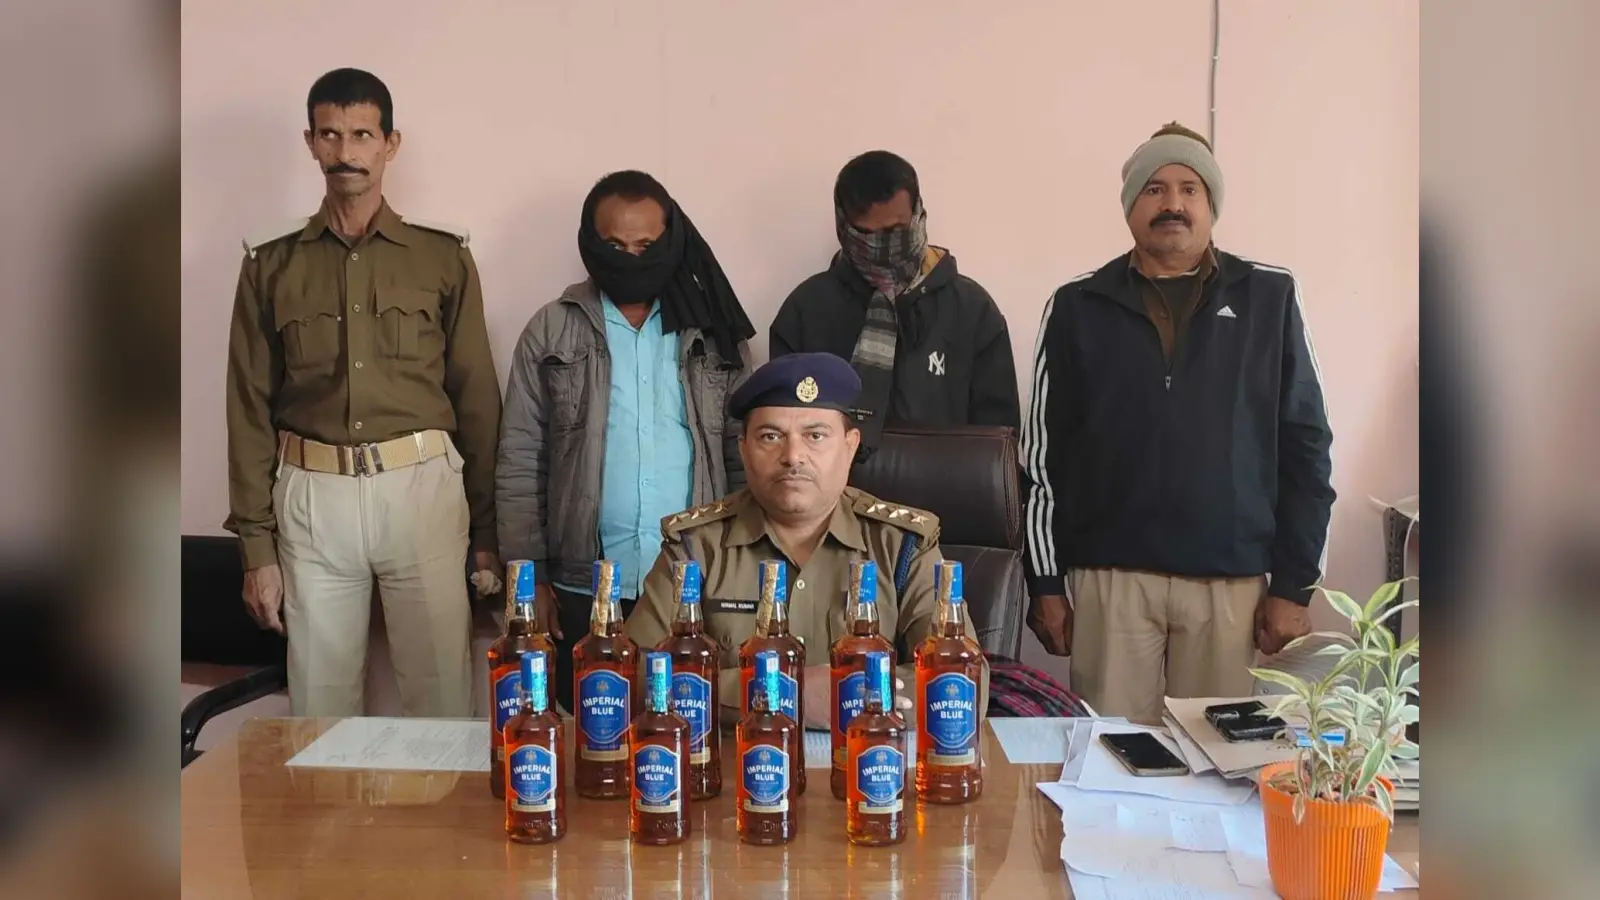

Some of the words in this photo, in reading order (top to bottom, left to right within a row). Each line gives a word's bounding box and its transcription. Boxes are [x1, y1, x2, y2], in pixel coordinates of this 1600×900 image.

[499, 697, 522, 709] IMPE
[582, 696, 625, 708] IMPERIAL
[674, 699, 706, 710] PERIAL
[841, 699, 864, 710] IMPE
[929, 699, 973, 711] IMPERIAL
[591, 706, 614, 715] BLUE
[940, 710, 964, 719] BLUE
[513, 764, 551, 775] IMPERIAL
[637, 764, 674, 776] IMPERIAL
[746, 764, 784, 775] IMPERIAL
[862, 765, 900, 777] IMPERIAL
[521, 773, 542, 781] BLUE
[644, 773, 665, 781] BLUE
[754, 773, 775, 781] BLUE
[871, 773, 892, 782] BLUE
